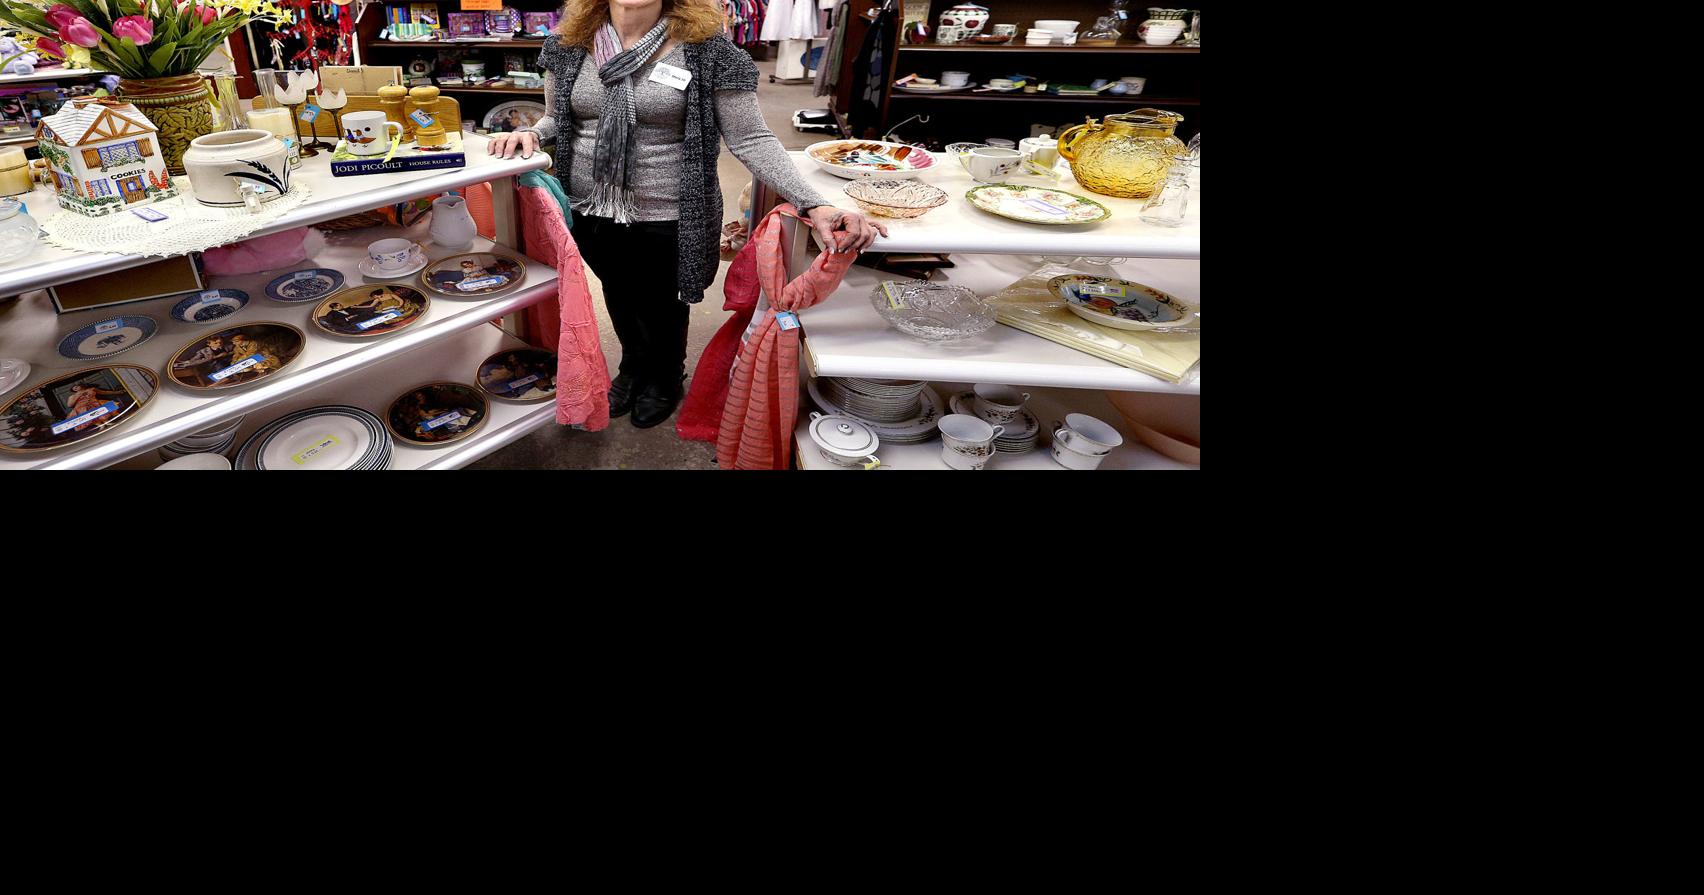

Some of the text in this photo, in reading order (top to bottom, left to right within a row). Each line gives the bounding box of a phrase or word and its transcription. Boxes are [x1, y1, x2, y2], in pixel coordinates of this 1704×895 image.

[335, 164, 358, 173] JODI
[361, 161, 403, 171] PICOULT
[110, 168, 146, 180] COOKIES
